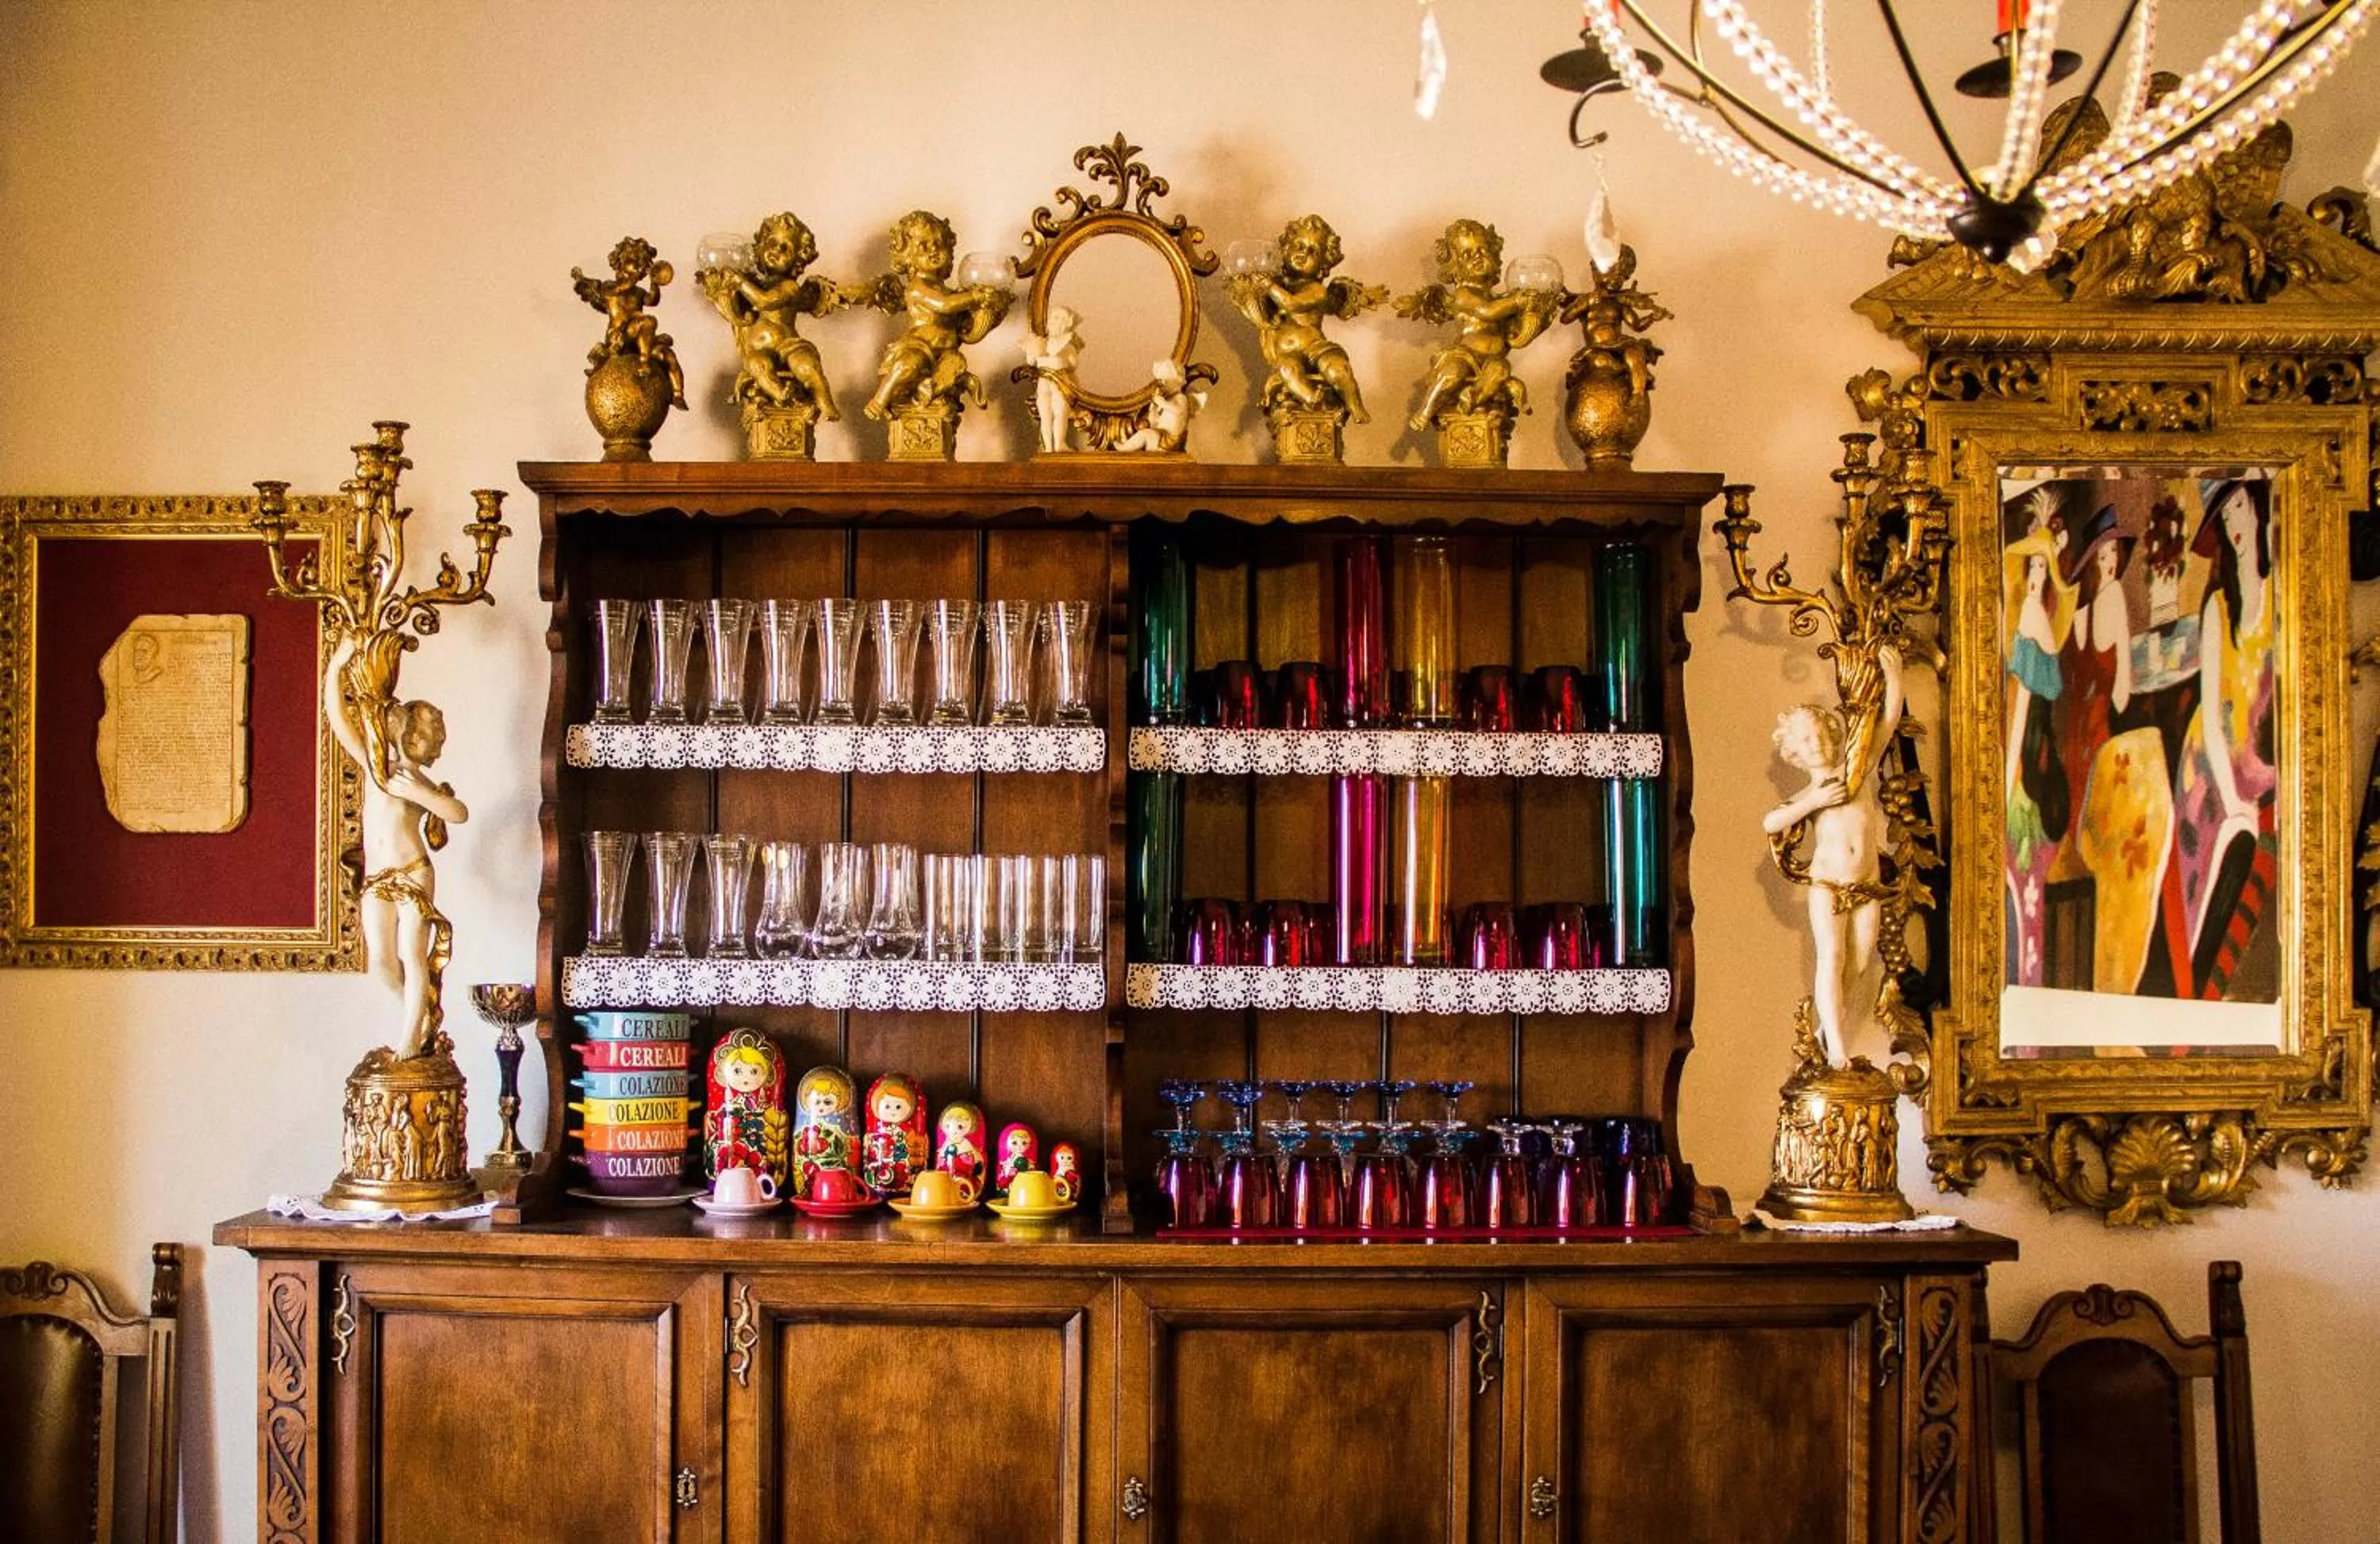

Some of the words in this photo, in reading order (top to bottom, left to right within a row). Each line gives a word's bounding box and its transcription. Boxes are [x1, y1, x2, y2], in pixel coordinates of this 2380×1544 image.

[622, 1019, 685, 1038] CEREALI
[620, 1047, 686, 1067] CEREALI
[620, 1076, 685, 1096] COLAZIONE
[609, 1101, 678, 1122] COLAZIONE
[617, 1129, 685, 1150] COLAZIONE
[608, 1156, 681, 1177] COLAZIONE
